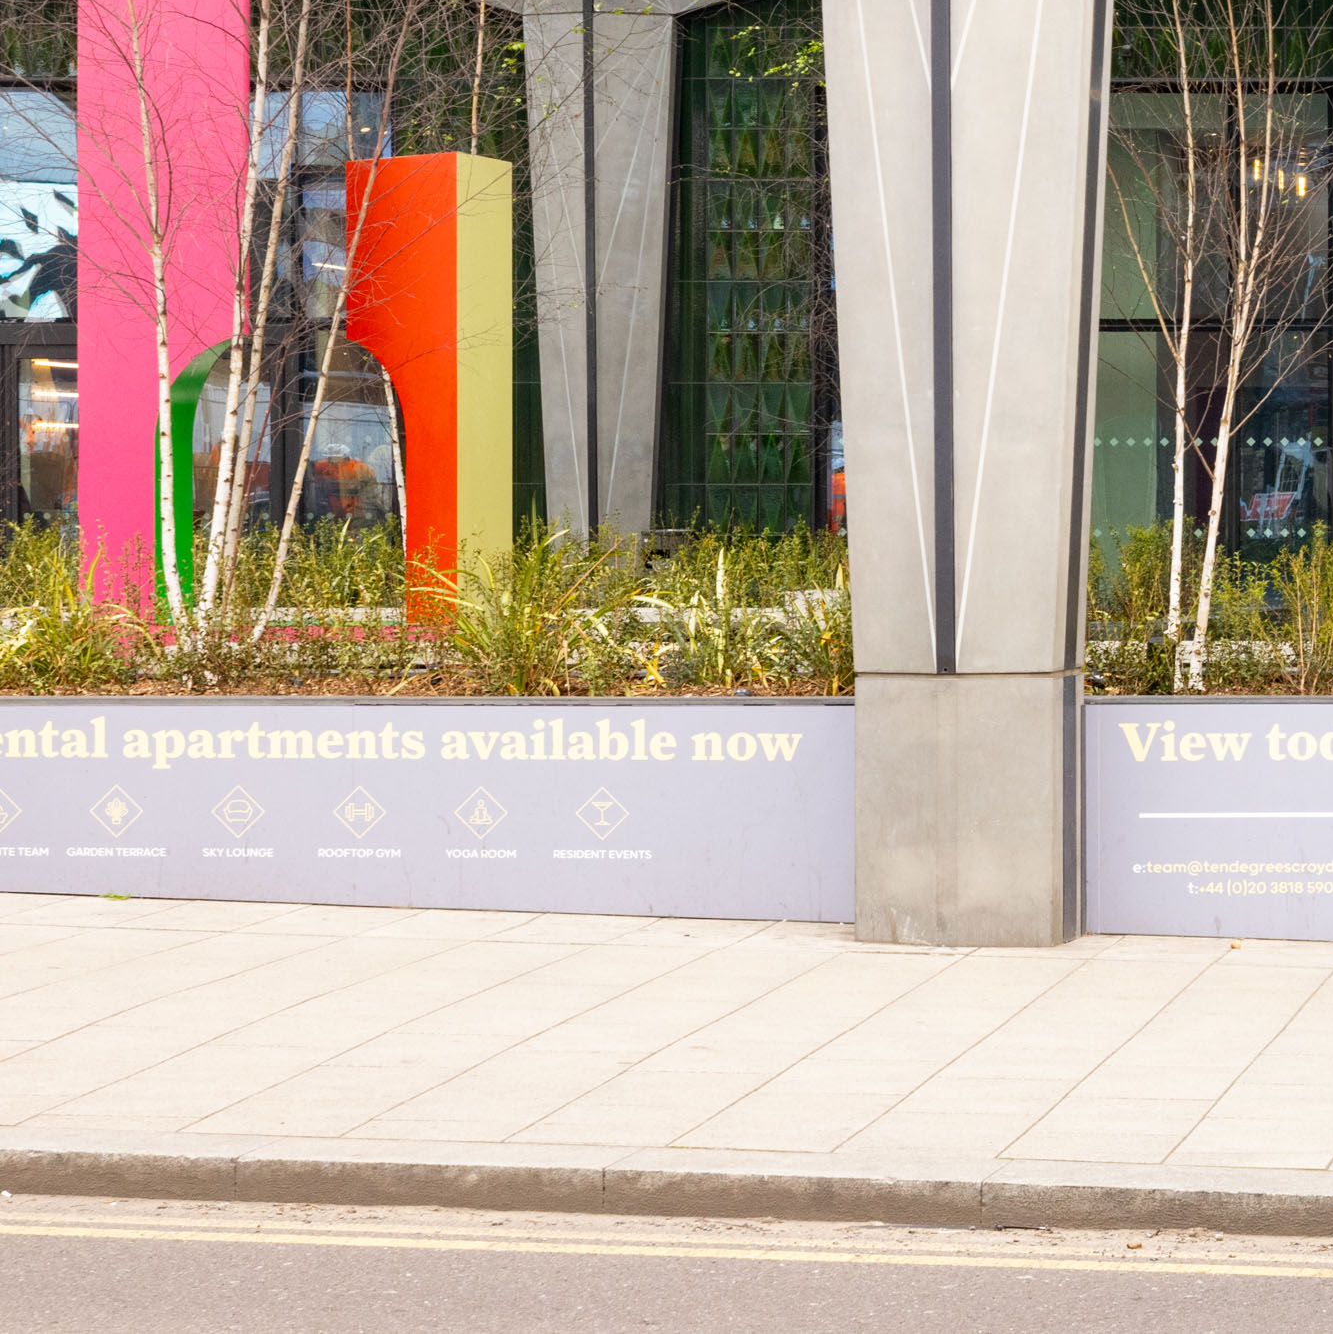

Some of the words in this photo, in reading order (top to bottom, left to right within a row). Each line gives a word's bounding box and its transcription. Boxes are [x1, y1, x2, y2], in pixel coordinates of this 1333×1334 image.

[0, 716, 109, 759] ntal
[122, 721, 427, 770] apartments
[439, 718, 677, 762] available
[691, 731, 804, 762] now
[1118, 719, 1253, 763] View
[18, 847, 49, 857] TEAM
[66, 847, 114, 857] GARDEN
[116, 847, 167, 857] TERRACE
[202, 847, 223, 857] SKY
[226, 847, 274, 858] LOUNGE
[317, 848, 373, 858] ROOFTOP
[375, 848, 402, 858] GYM
[446, 849, 479, 859] YOGA
[481, 849, 517, 859] ROOM
[552, 849, 606, 859] RESIDENT
[608, 849, 653, 860] EVENTS
[1187, 881, 1224, 895] t:+44
[1227, 881, 1266, 896] (0)20
[1270, 881, 1303, 895] 3818
